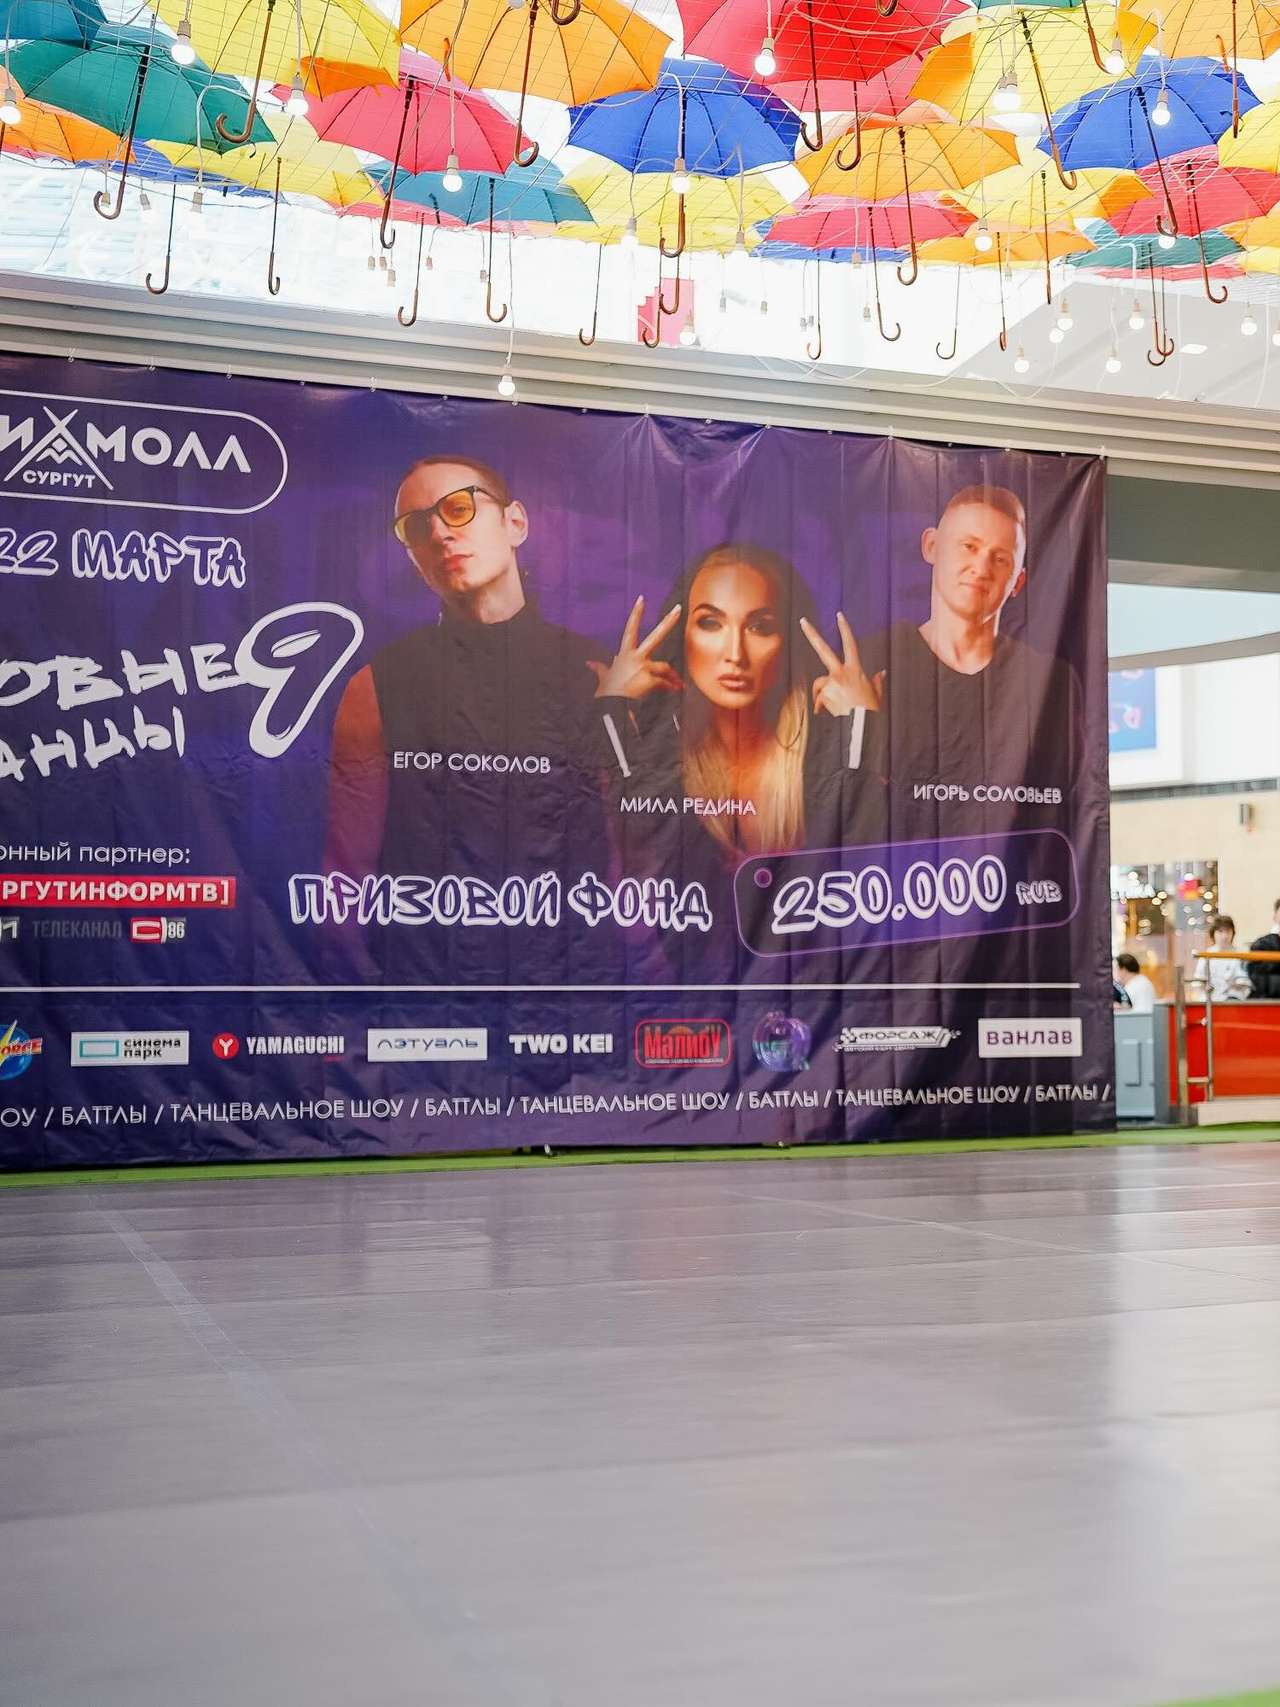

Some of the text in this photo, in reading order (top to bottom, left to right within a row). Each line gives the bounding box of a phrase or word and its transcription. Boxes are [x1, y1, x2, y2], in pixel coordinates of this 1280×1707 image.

[86, 421, 252, 473] МОЛЛ
[22, 469, 96, 489] СУРГУТ
[71, 528, 246, 589] МАРТА
[393, 751, 551, 774] ЕГОР СОКОЛОВ
[914, 784, 1062, 804] ИГОРЬ СОЛОВЬЕВ
[620, 796, 757, 817] МИЛА РЕДИНА
[79, 846, 191, 868] партнер:
[288, 871, 713, 932] ПРИЗОВОЙ ФОНД
[771, 853, 1063, 935] 250.000 RUB
[33, 920, 123, 938] ТЕЛЕКАНАЛ
[124, 1038, 181, 1048] синема
[246, 1035, 345, 1055] YAMAGUCHI
[509, 1033, 613, 1054] TWO KEI
[858, 1030, 937, 1040] ФОРСАЖ
[986, 1029, 1073, 1046] ванлав
[124, 1048, 163, 1061] парк
[62, 1104, 146, 1126] БАТТЛЫ
[170, 1099, 345, 1124] ТАНЦЕВАЛЬНОЕ
[351, 1098, 404, 1120] ШОУ
[425, 1097, 501, 1117] БАТТЛЫ
[520, 1093, 677, 1115] ТАНЦЕВАЛЬНОЕ
[682, 1092, 730, 1112] ШОУ
[749, 1090, 819, 1109] БАТТЛЫ
[836, 1086, 973, 1107] ТАНЦЕВАЛЬНОЕ
[977, 1085, 1020, 1104] ШОУ
[1035, 1084, 1098, 1102] БАТТЛЫ
